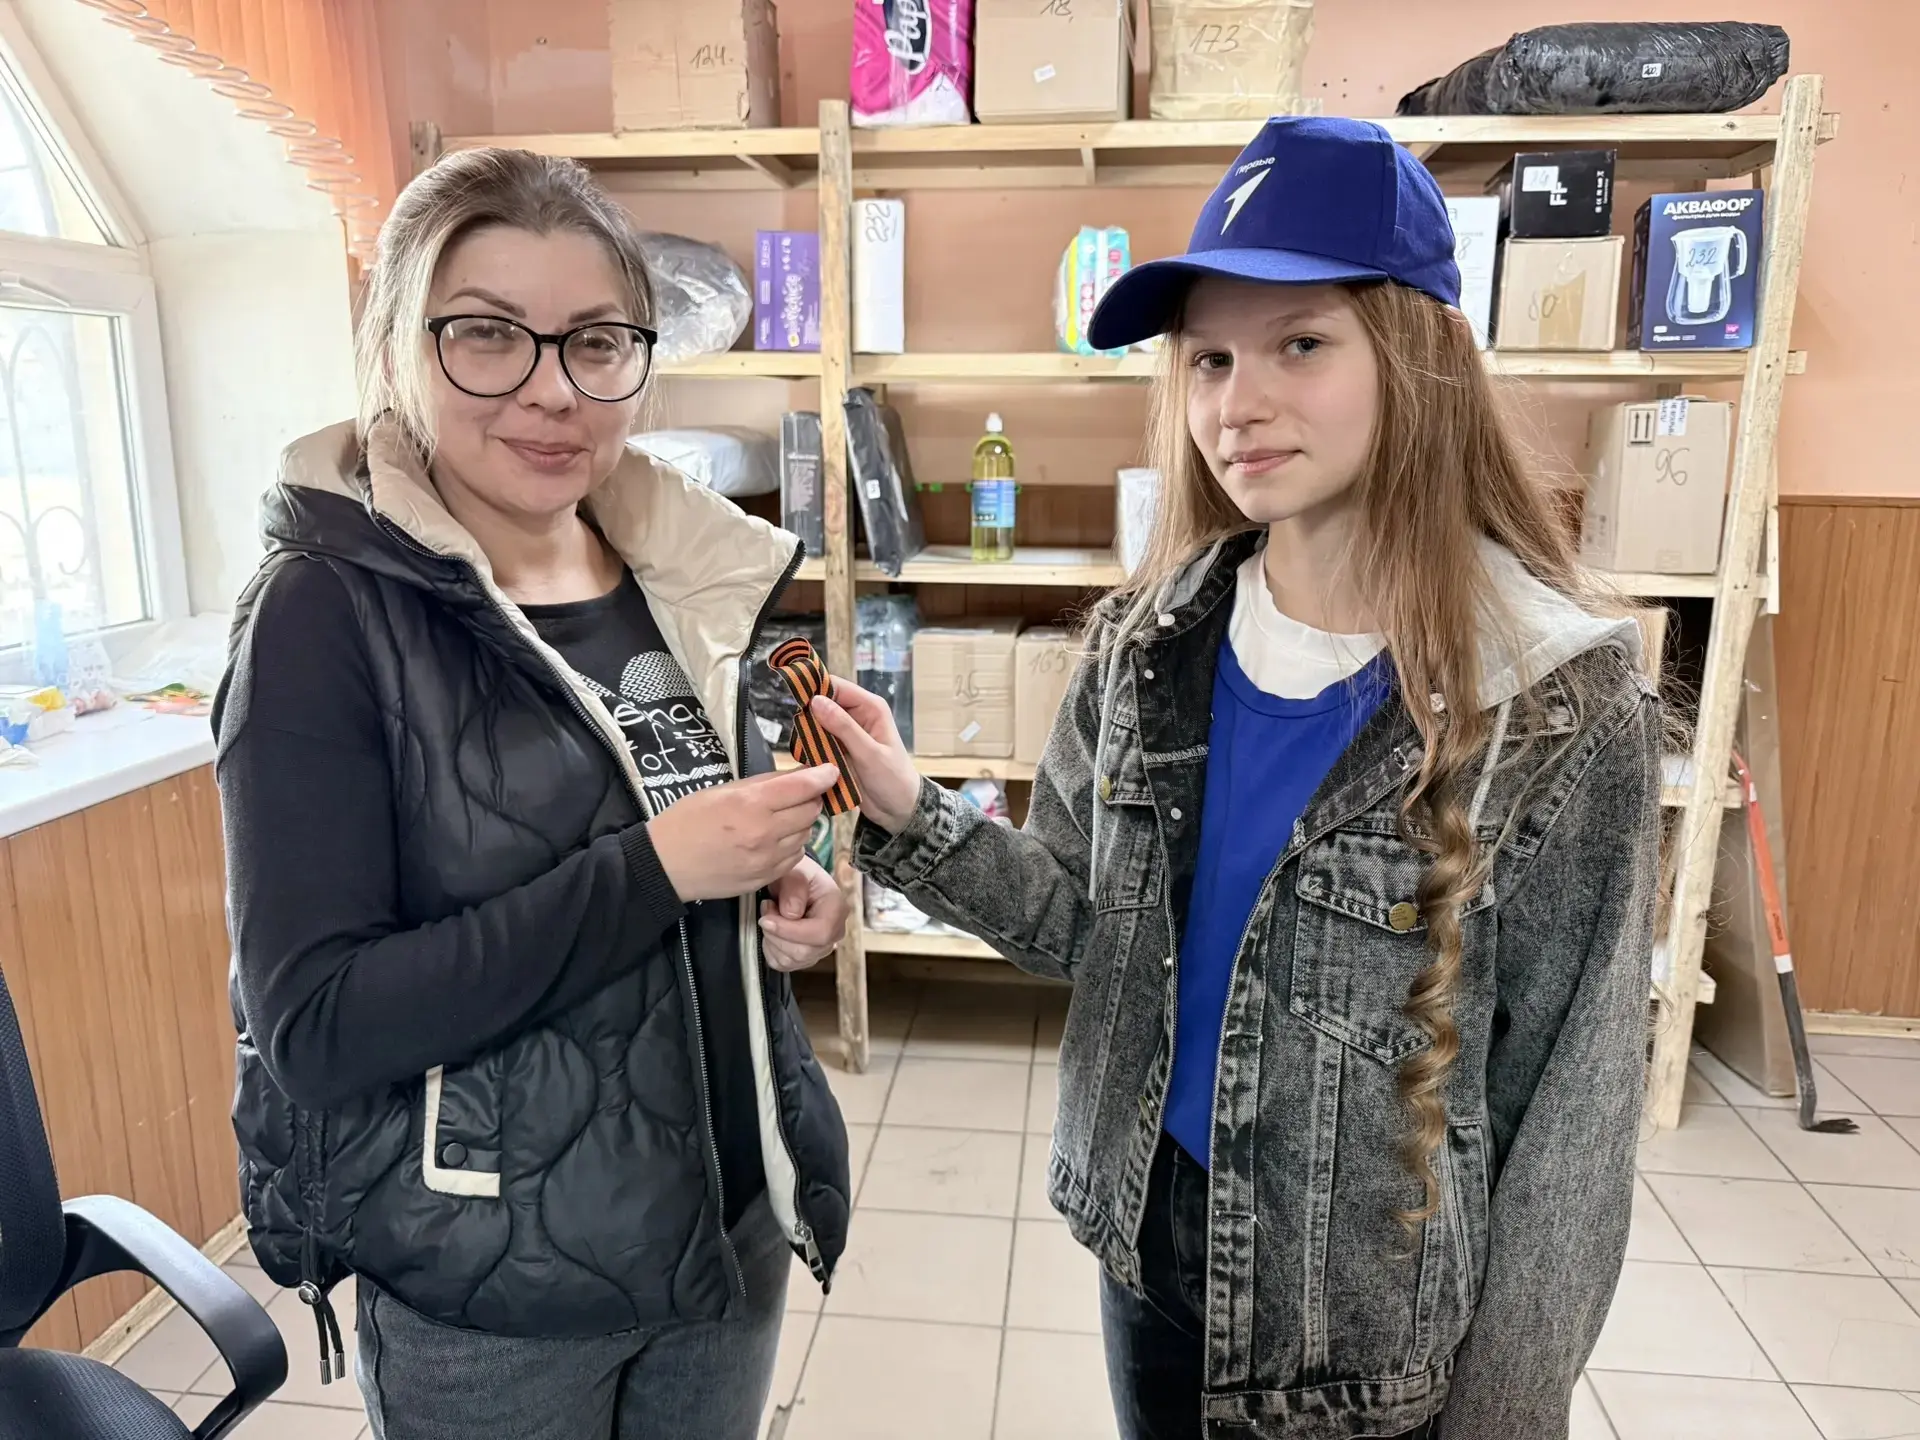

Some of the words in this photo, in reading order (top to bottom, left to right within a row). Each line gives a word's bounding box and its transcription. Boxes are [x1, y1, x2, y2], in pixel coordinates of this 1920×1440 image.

[1189, 24, 1240, 53] 173
[1234, 156, 1276, 177] Первые
[1663, 198, 1751, 216] АКВАФОР
[1685, 247, 1717, 268] 232
[1655, 447, 1690, 486] 96
